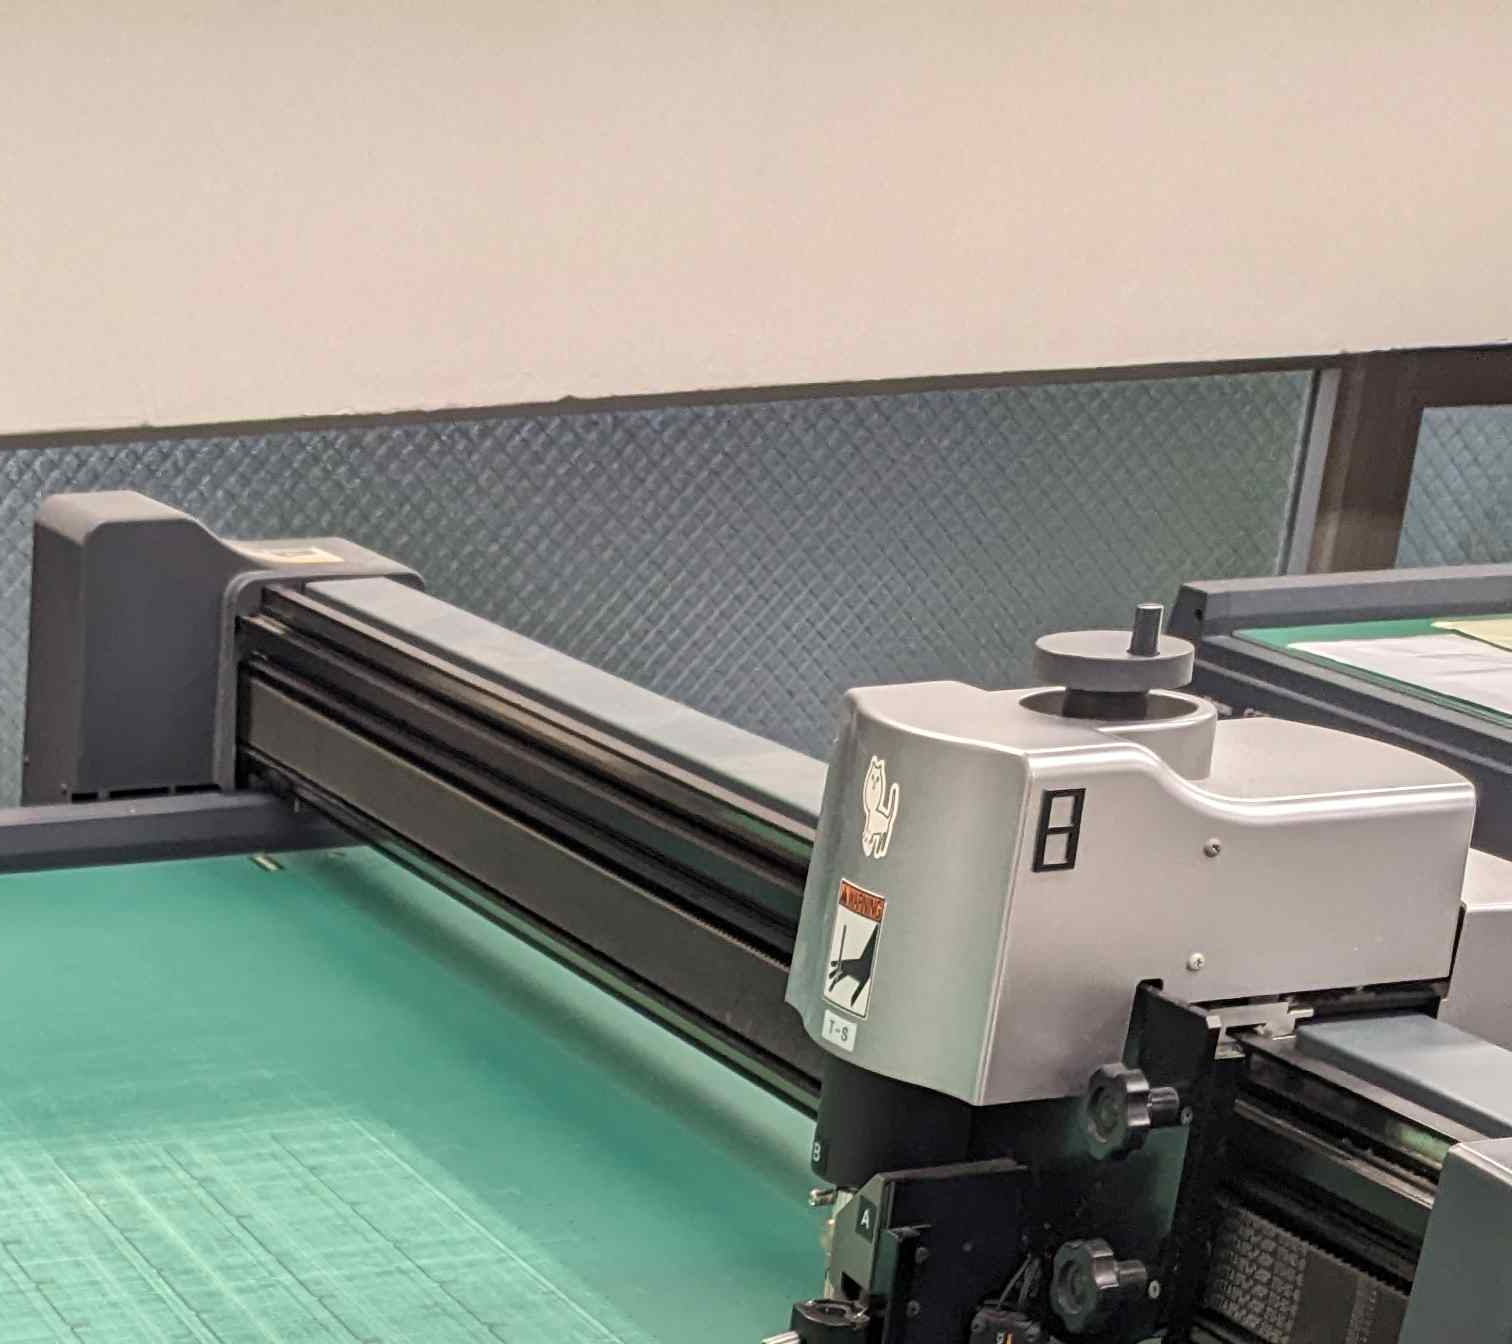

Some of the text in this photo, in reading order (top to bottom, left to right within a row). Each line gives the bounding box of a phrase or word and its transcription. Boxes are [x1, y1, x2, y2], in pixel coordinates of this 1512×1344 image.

[828, 1019, 849, 1042] T-S
[812, 1141, 821, 1162] B
[860, 1208, 870, 1229] A
